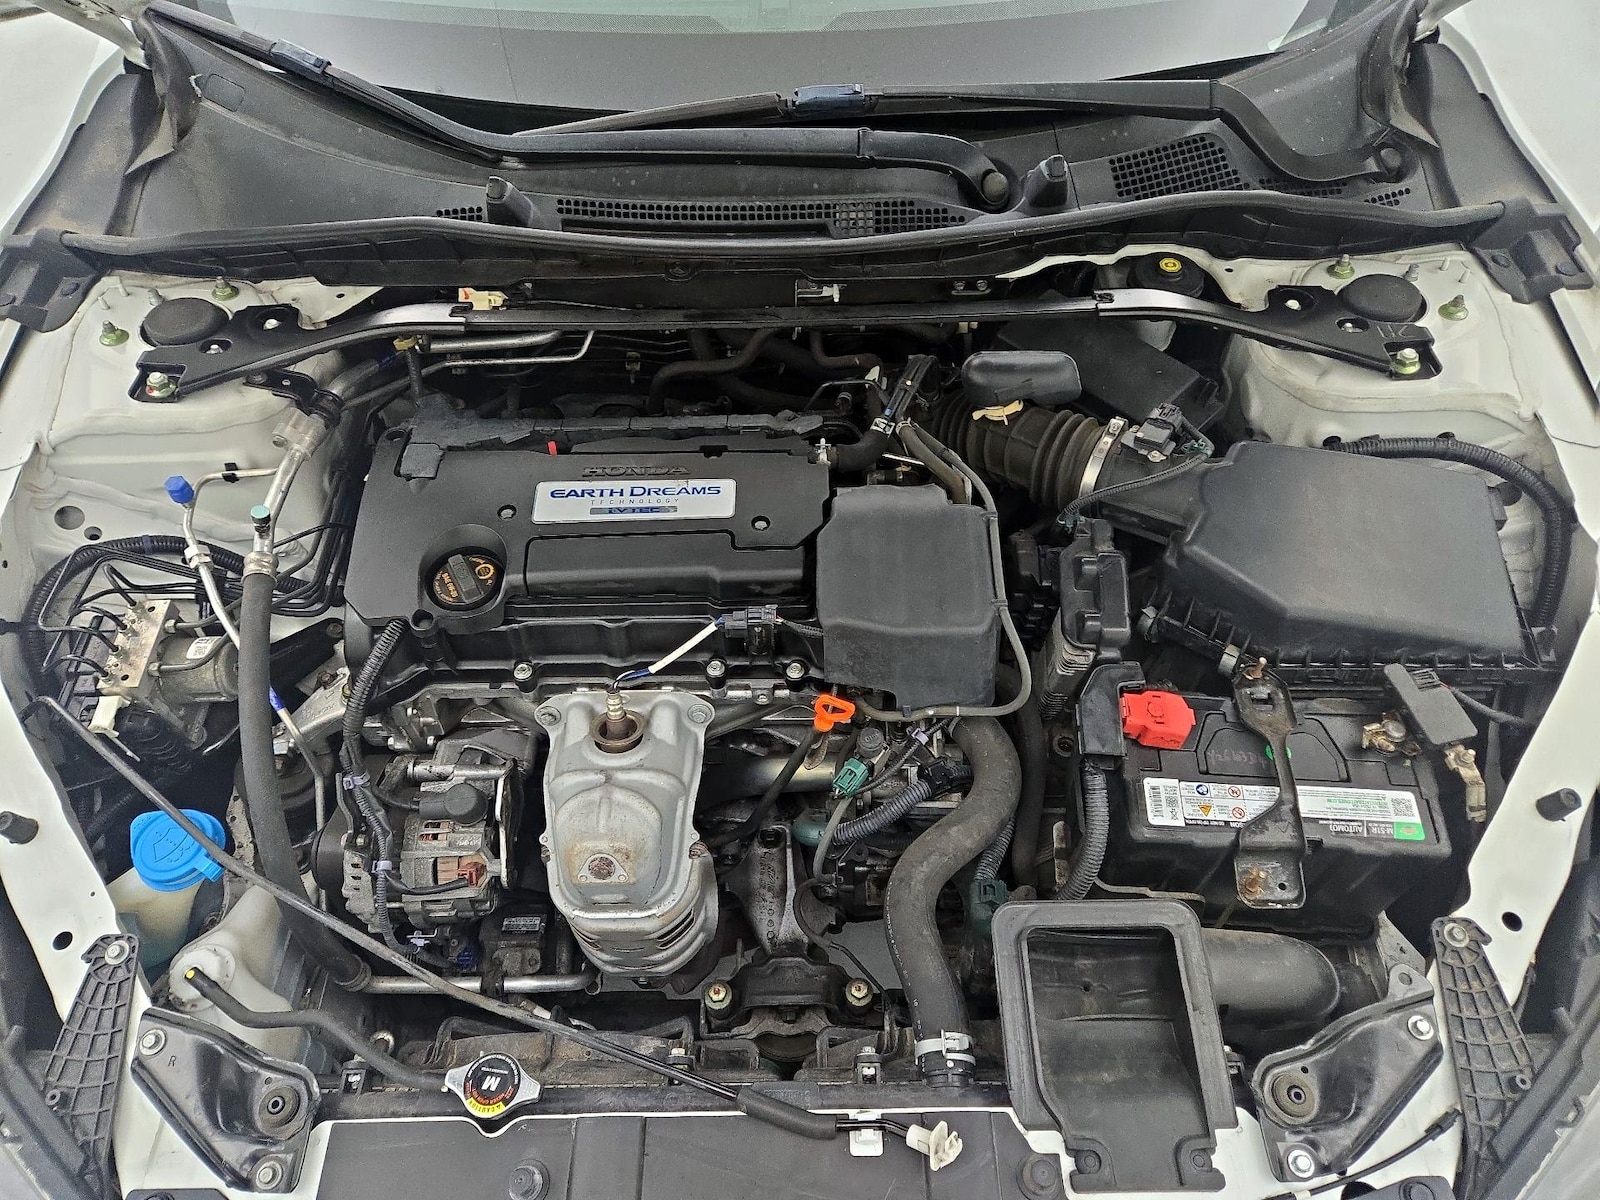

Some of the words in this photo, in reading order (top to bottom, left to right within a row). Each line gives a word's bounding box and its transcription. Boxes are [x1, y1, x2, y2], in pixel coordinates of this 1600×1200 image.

[582, 466, 690, 477] HONDA
[550, 488, 624, 498] EARTH
[630, 486, 721, 497] DREAMS
[591, 498, 680, 506] TECHNOLOGY
[167, 1055, 177, 1067] R
[468, 1100, 495, 1113] CAUTION
